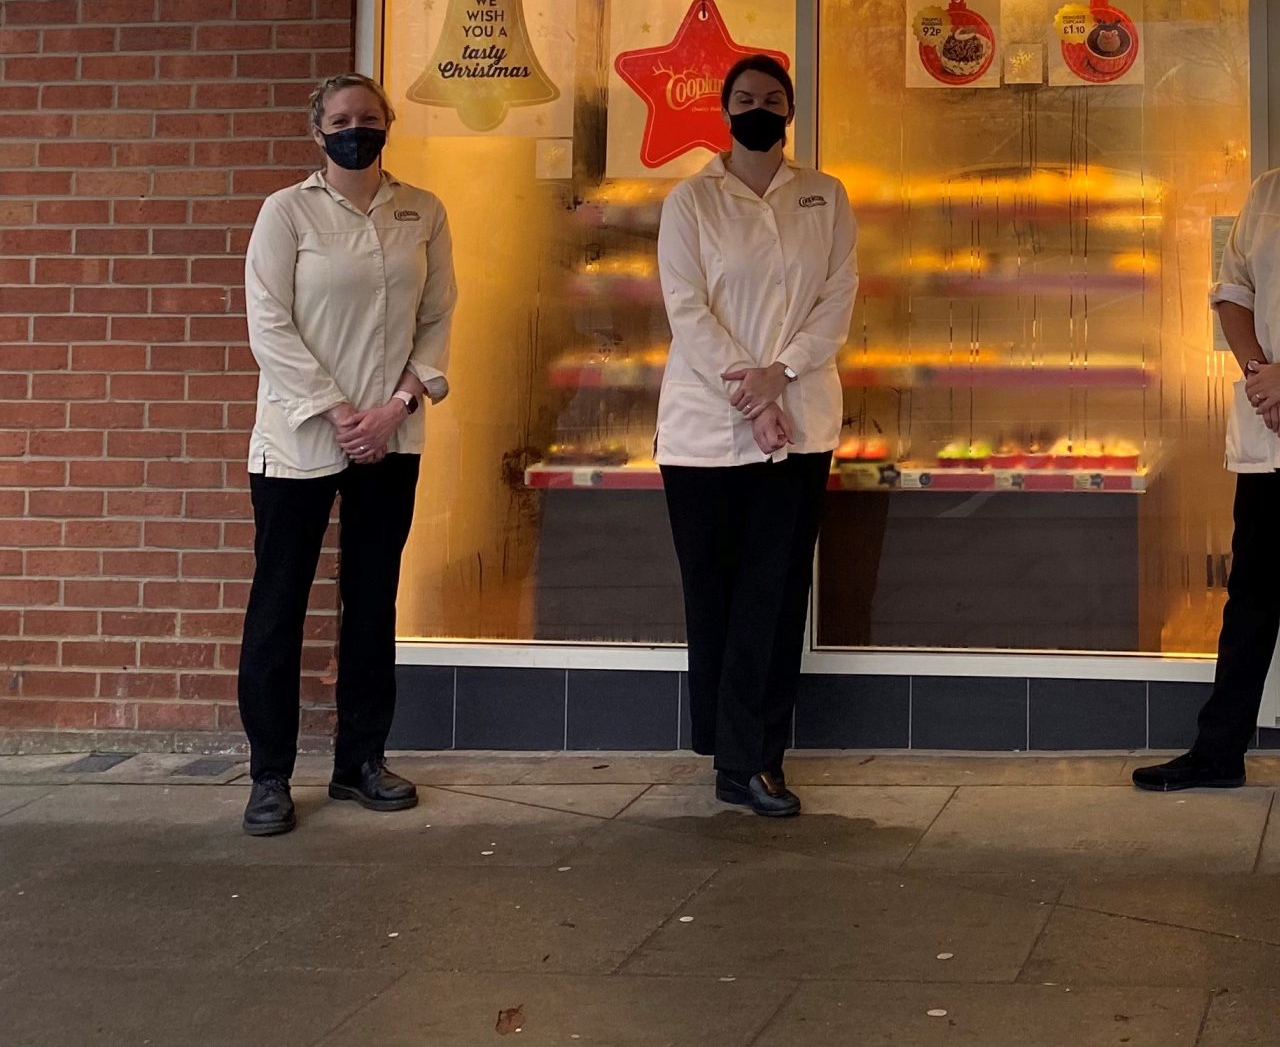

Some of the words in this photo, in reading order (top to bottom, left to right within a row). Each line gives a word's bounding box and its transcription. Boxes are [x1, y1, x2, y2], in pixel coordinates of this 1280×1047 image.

[466, 10, 505, 22] WISH
[462, 25, 494, 37] YOU
[498, 25, 508, 37] A
[1063, 25, 1085, 34] £1.10
[462, 44, 508, 65] tasty
[438, 61, 532, 79] Christmas
